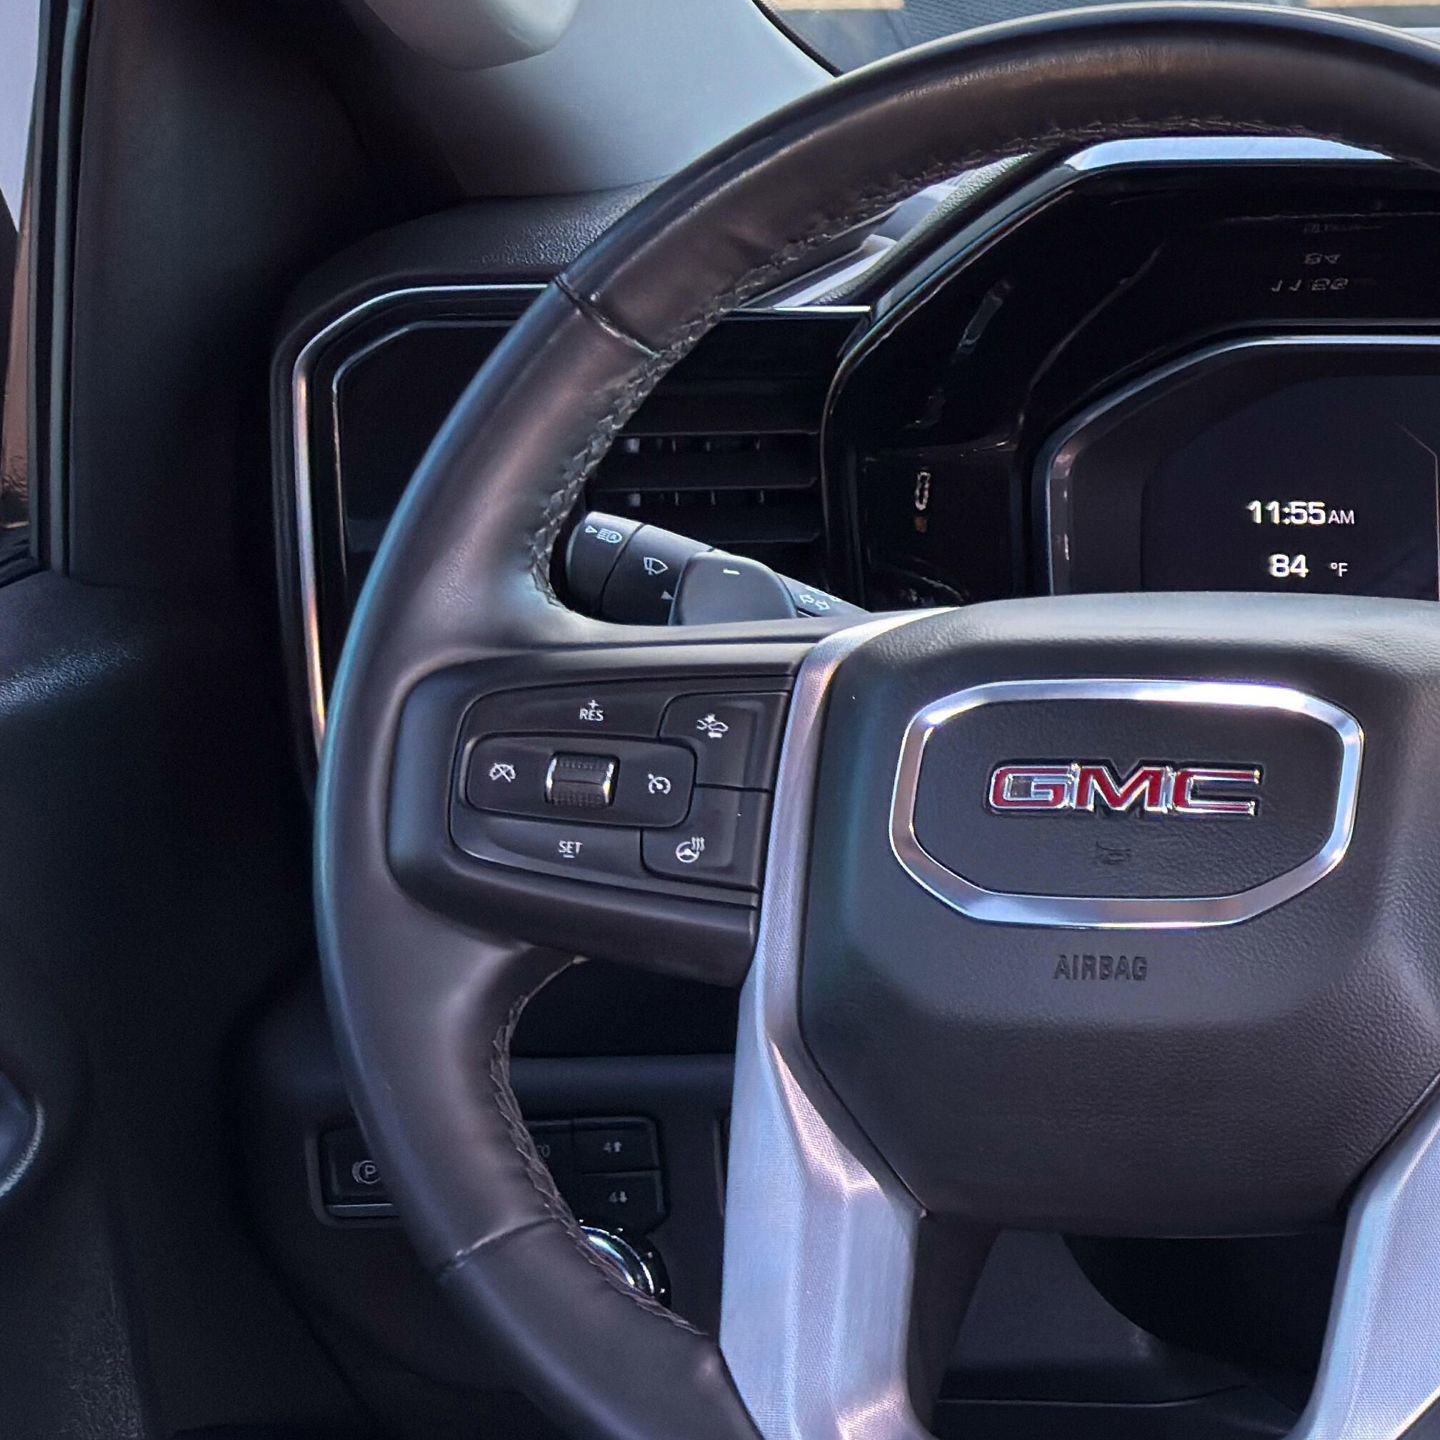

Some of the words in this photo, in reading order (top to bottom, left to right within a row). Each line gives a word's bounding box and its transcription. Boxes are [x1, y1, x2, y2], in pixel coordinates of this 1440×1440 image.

[1269, 553, 1309, 578] 84
[579, 708, 604, 722] RES
[988, 762, 1263, 817] GMC
[558, 840, 583, 854] SET
[1053, 955, 1148, 981] AIRBAG
